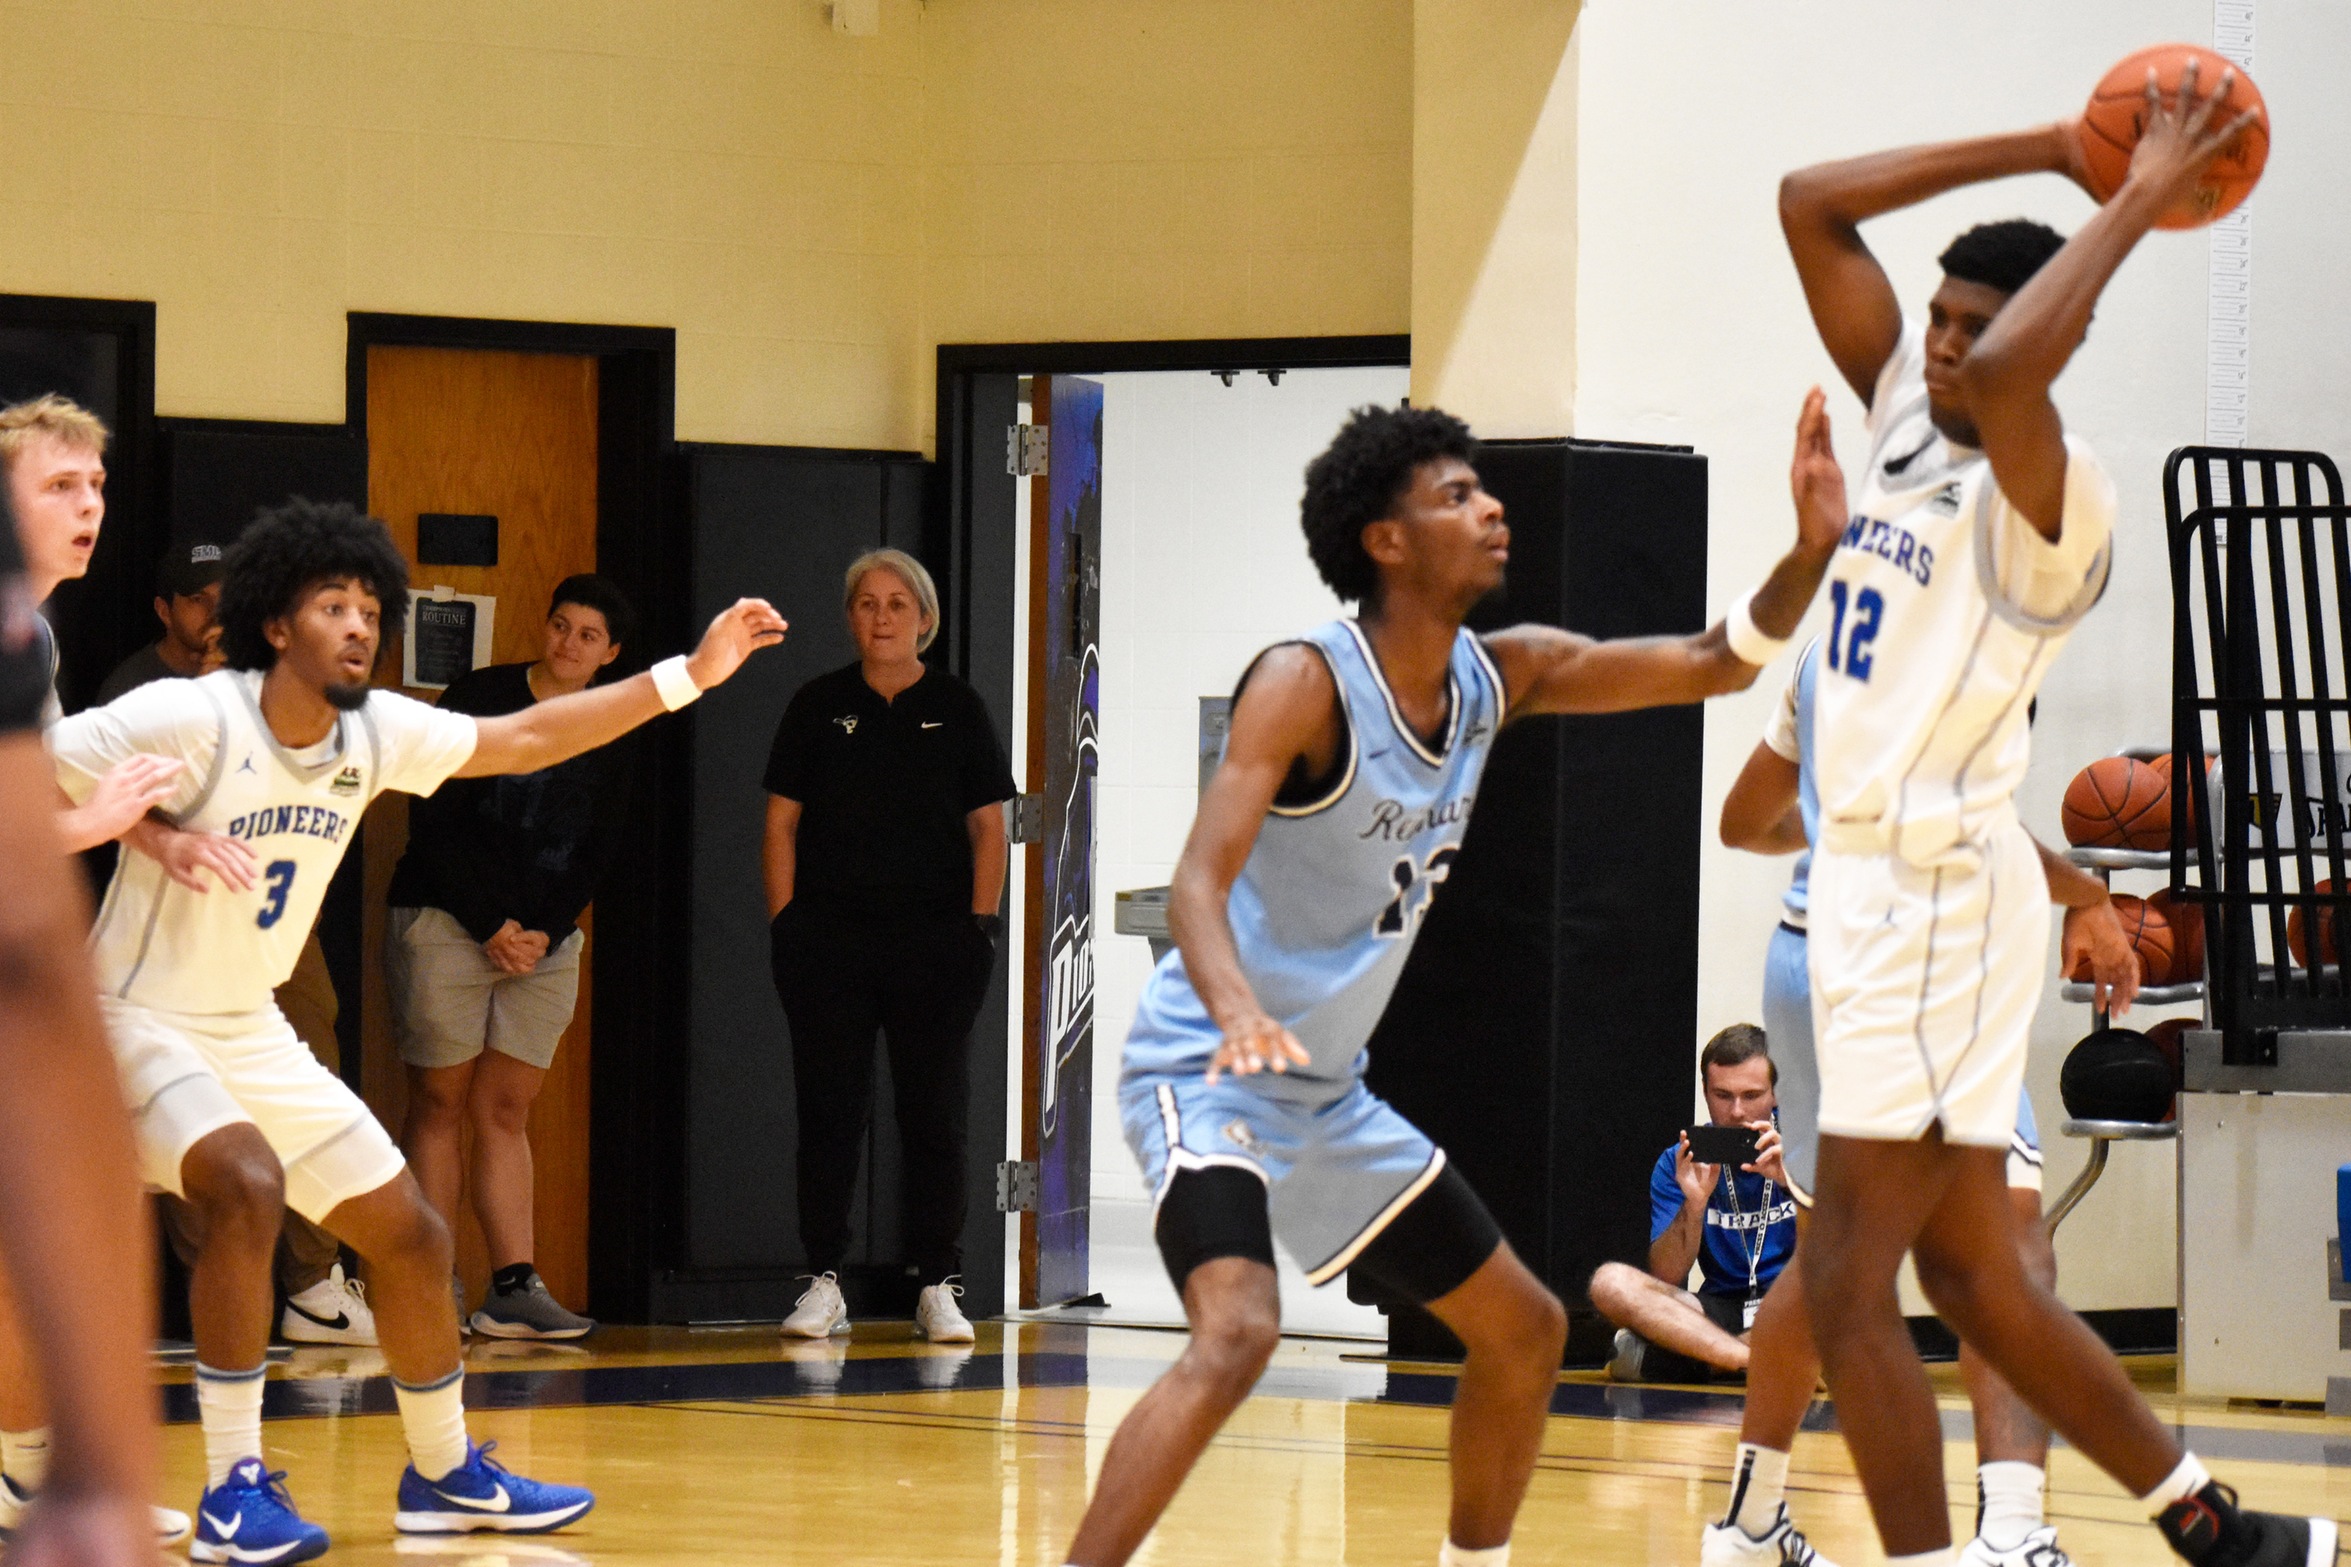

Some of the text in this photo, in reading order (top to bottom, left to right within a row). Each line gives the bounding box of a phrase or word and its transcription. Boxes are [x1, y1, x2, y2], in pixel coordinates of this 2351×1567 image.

[1840, 514, 1934, 587] NEERS
[422, 611, 466, 625] ROUTINE
[1828, 579, 1884, 683] 12
[256, 859, 297, 929] 3
